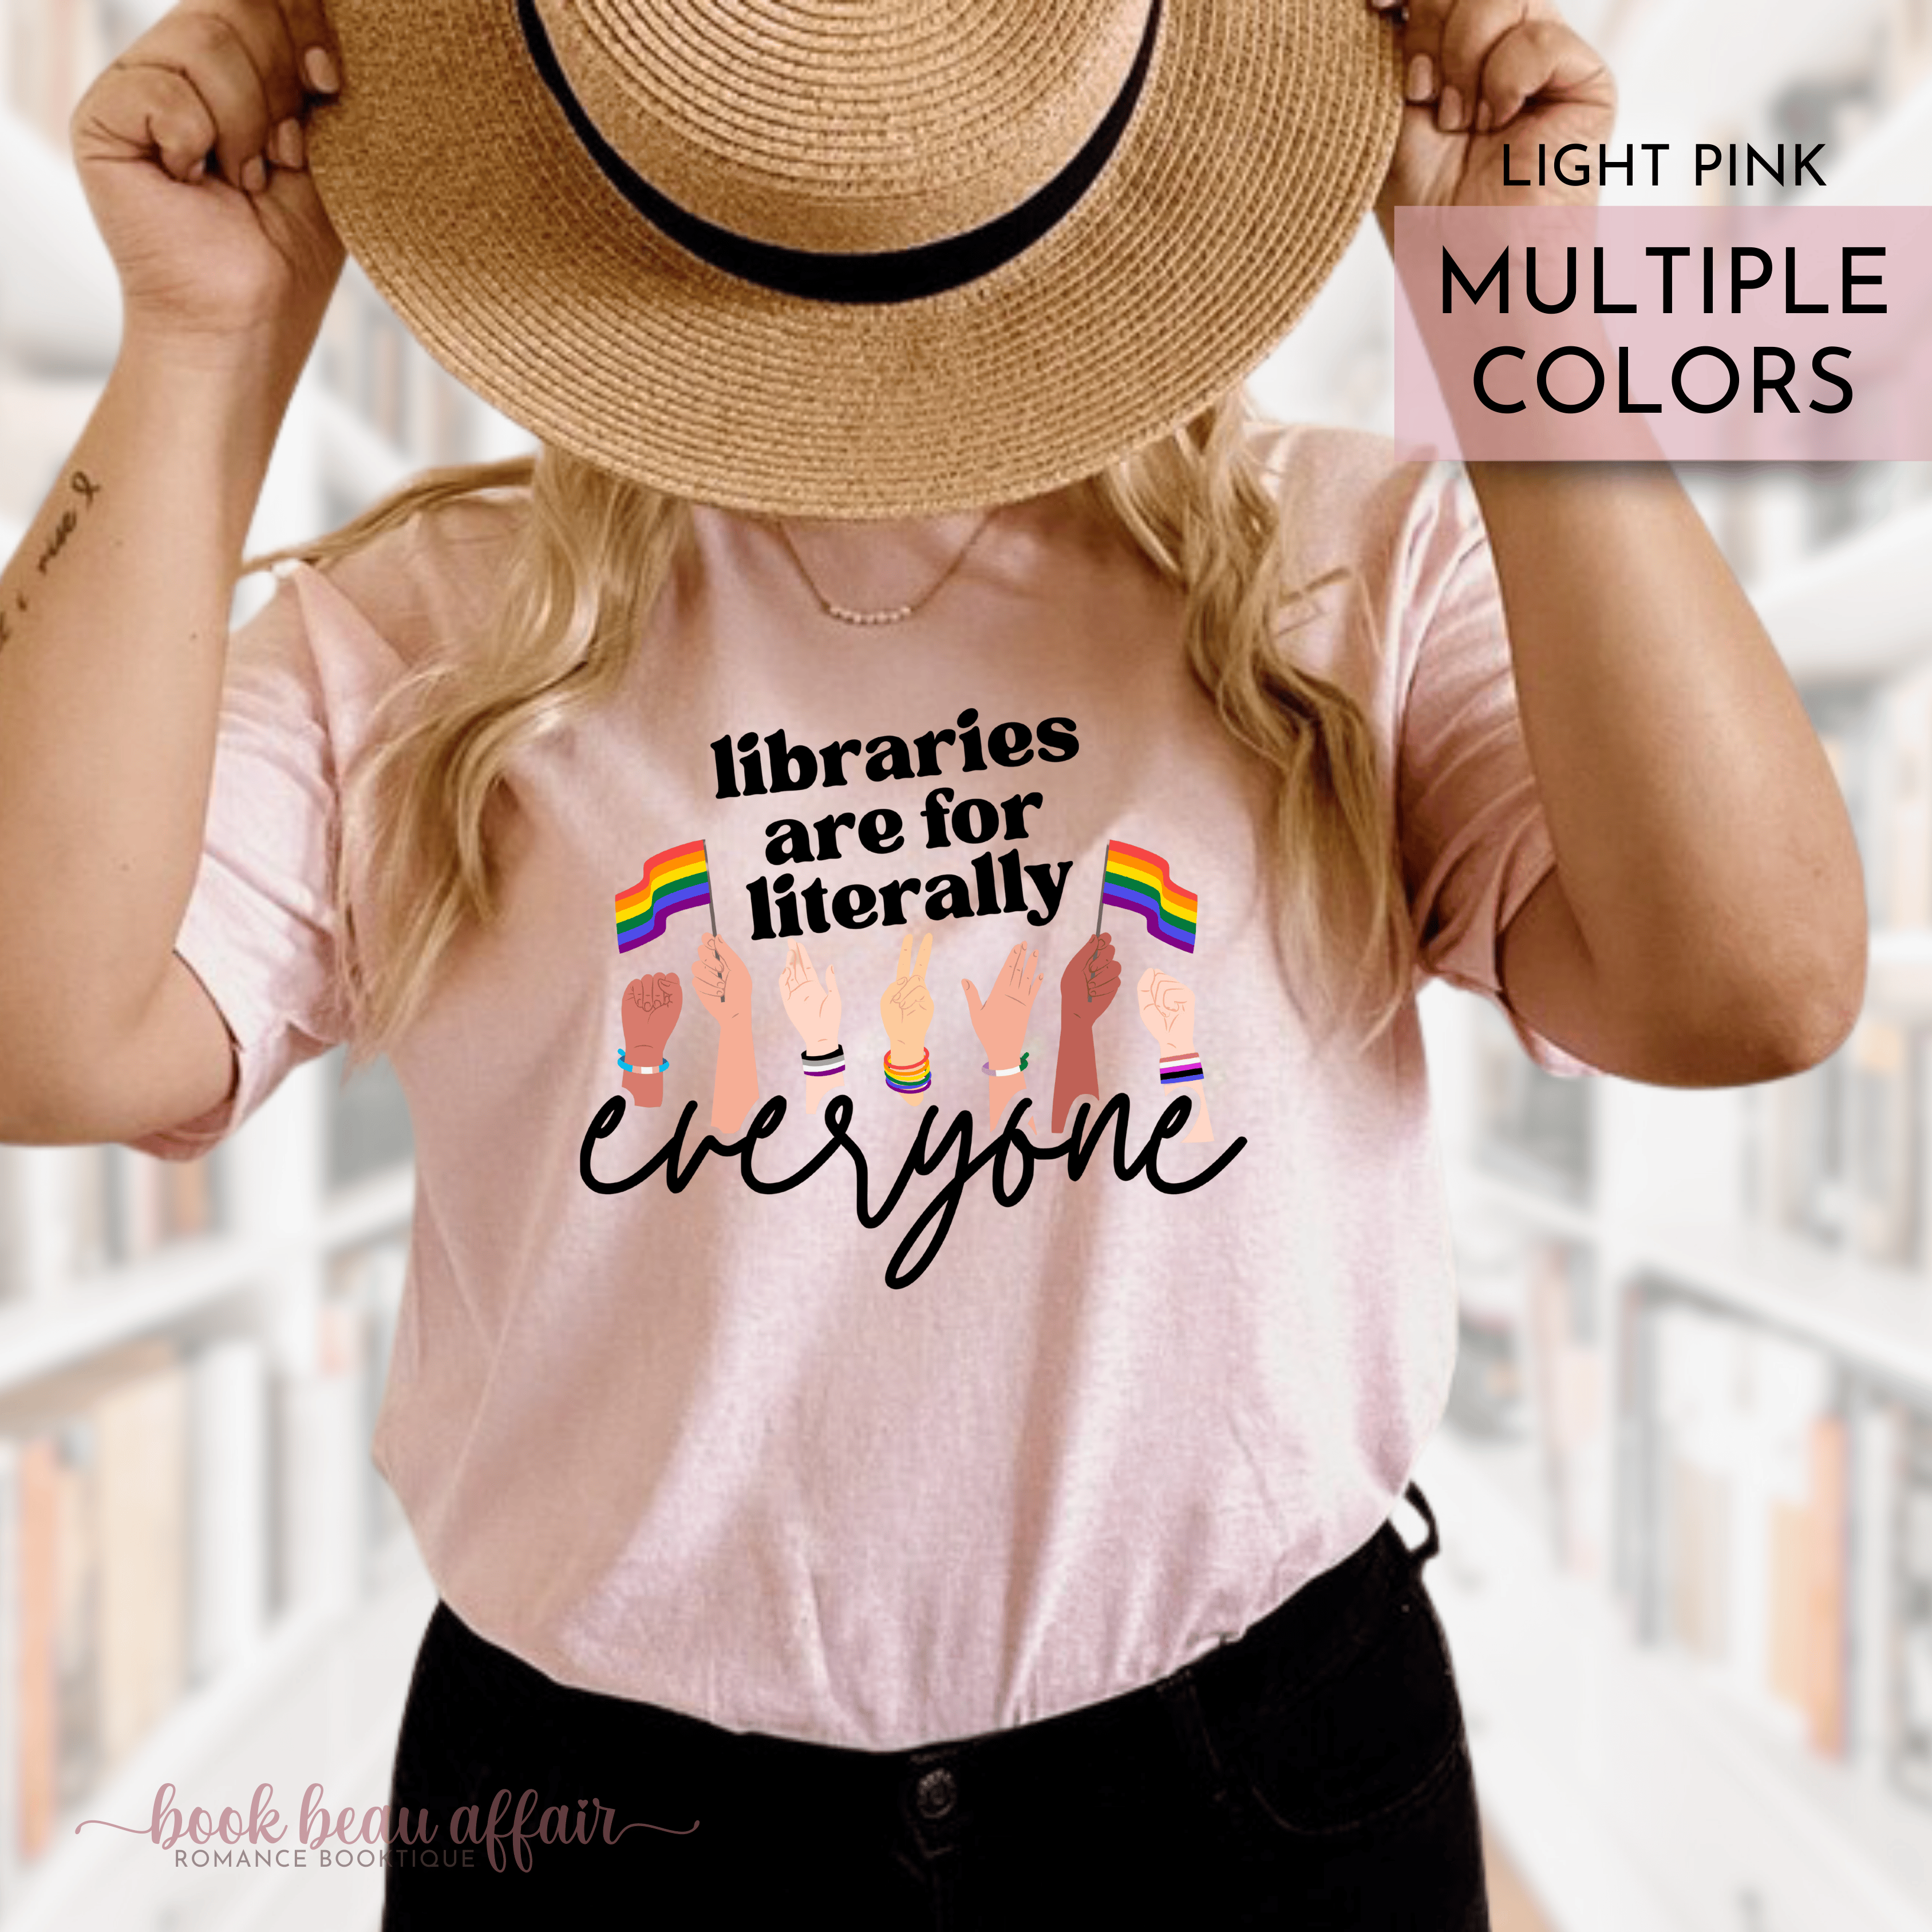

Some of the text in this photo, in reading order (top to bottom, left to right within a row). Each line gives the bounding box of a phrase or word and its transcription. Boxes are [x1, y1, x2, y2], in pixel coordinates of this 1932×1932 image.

[710, 708, 1080, 799] libraries
[765, 787, 1044, 866] are for
[745, 848, 1074, 941] literally
[579, 1093, 1248, 1290] everyone
